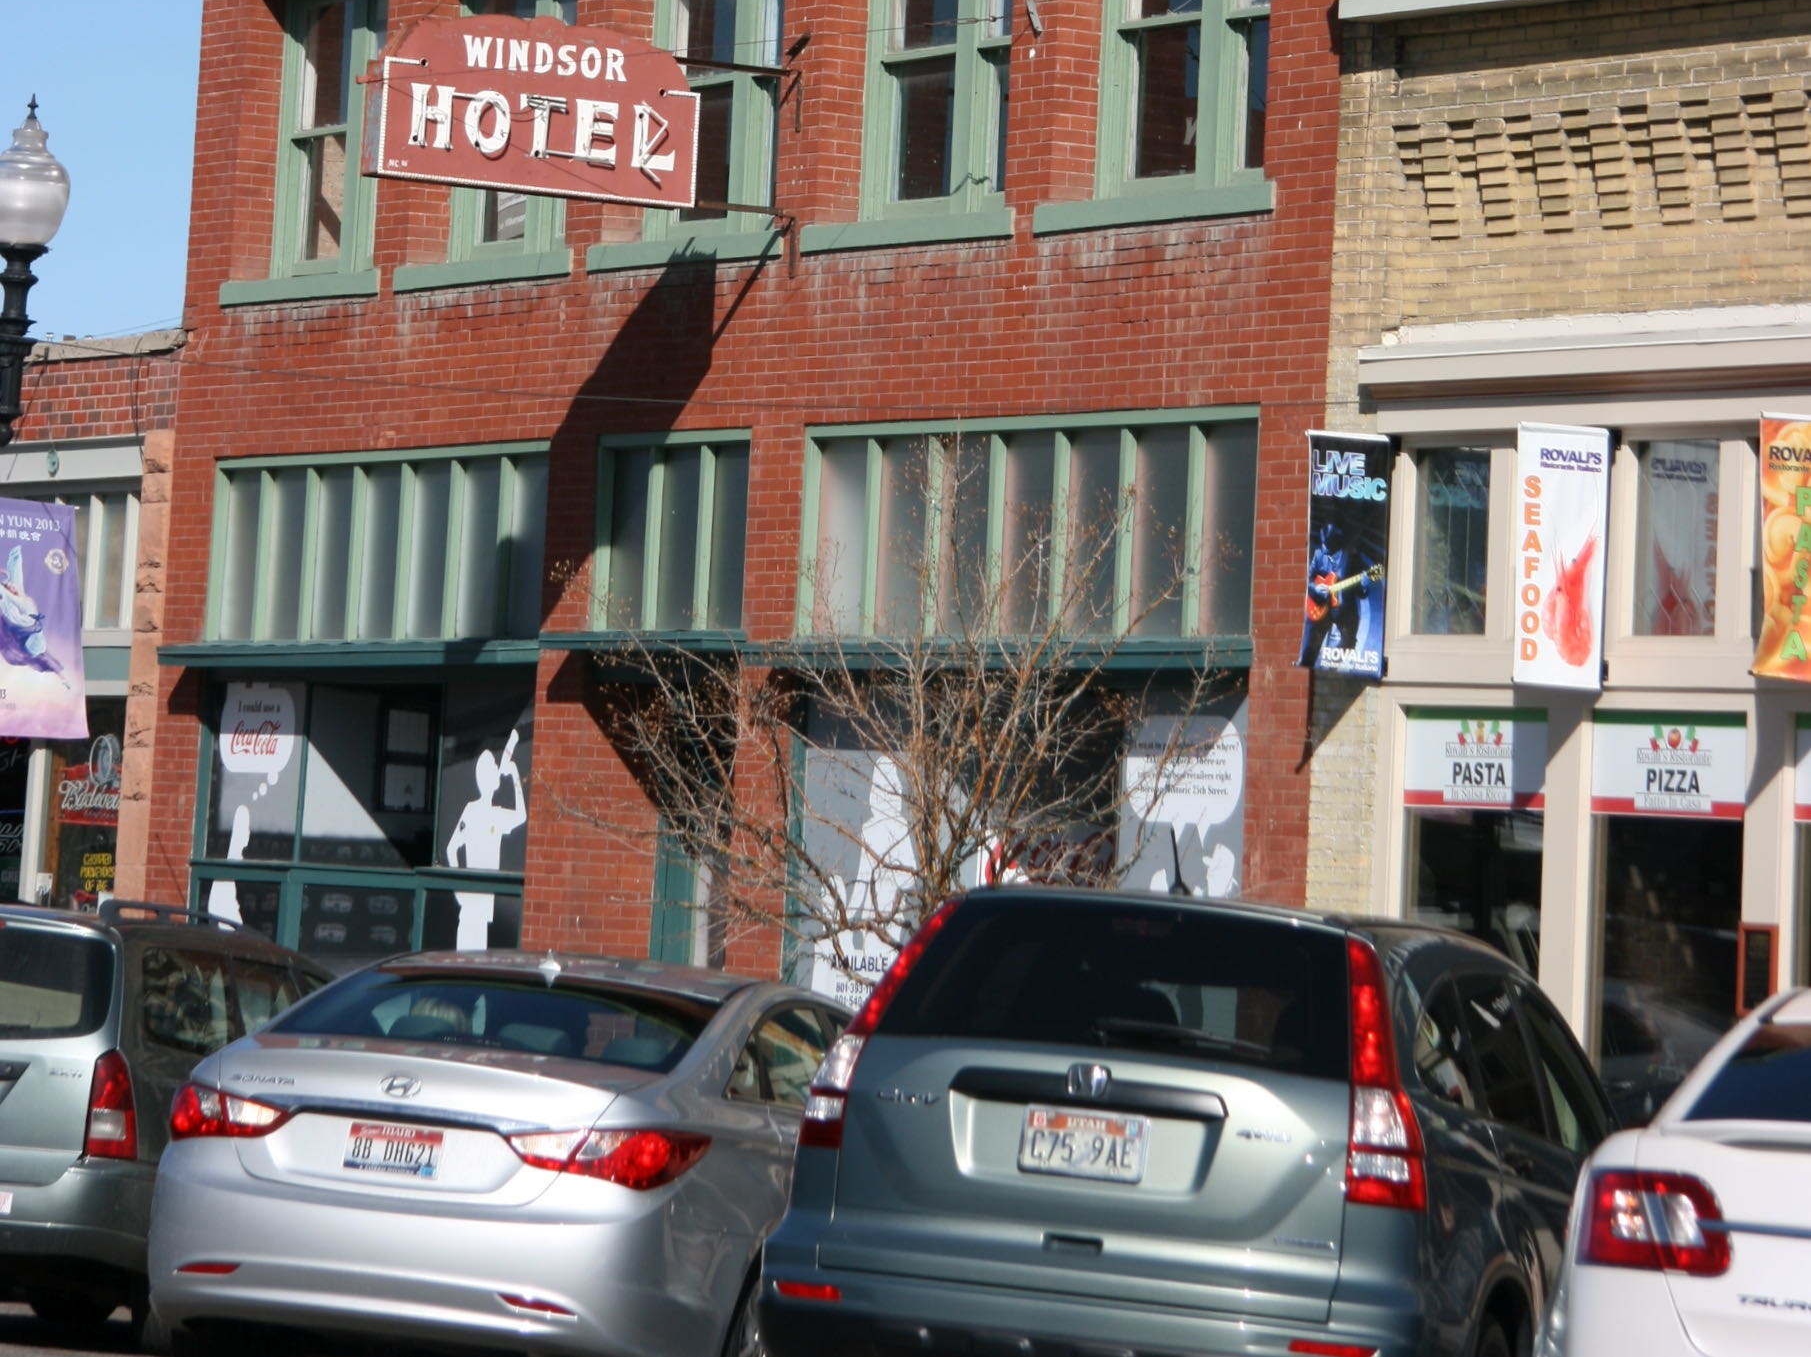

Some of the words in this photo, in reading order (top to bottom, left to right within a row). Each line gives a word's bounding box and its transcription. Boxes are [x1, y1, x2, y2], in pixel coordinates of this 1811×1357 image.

[463, 35, 627, 83] WINDSOR
[408, 82, 676, 173] HOTEL
[1312, 448, 1367, 477] LIVE
[1540, 447, 1603, 466] ROVALI'S
[1312, 472, 1388, 502] MUSIC
[7, 515, 33, 529] YUN
[35, 517, 61, 532] 2013
[1520, 475, 1542, 662] SEAFOOD
[1780, 485, 1811, 662] PASTA
[1322, 647, 1379, 664] ROVALI'S
[1452, 762, 1506, 785] PASTA
[1646, 768, 1700, 793] PIZZA
[831, 953, 889, 973] AVAILABLE
[352, 1136, 373, 1160] 8B
[1030, 1130, 1075, 1164] C75
[1090, 1135, 1135, 1169] 9AE
